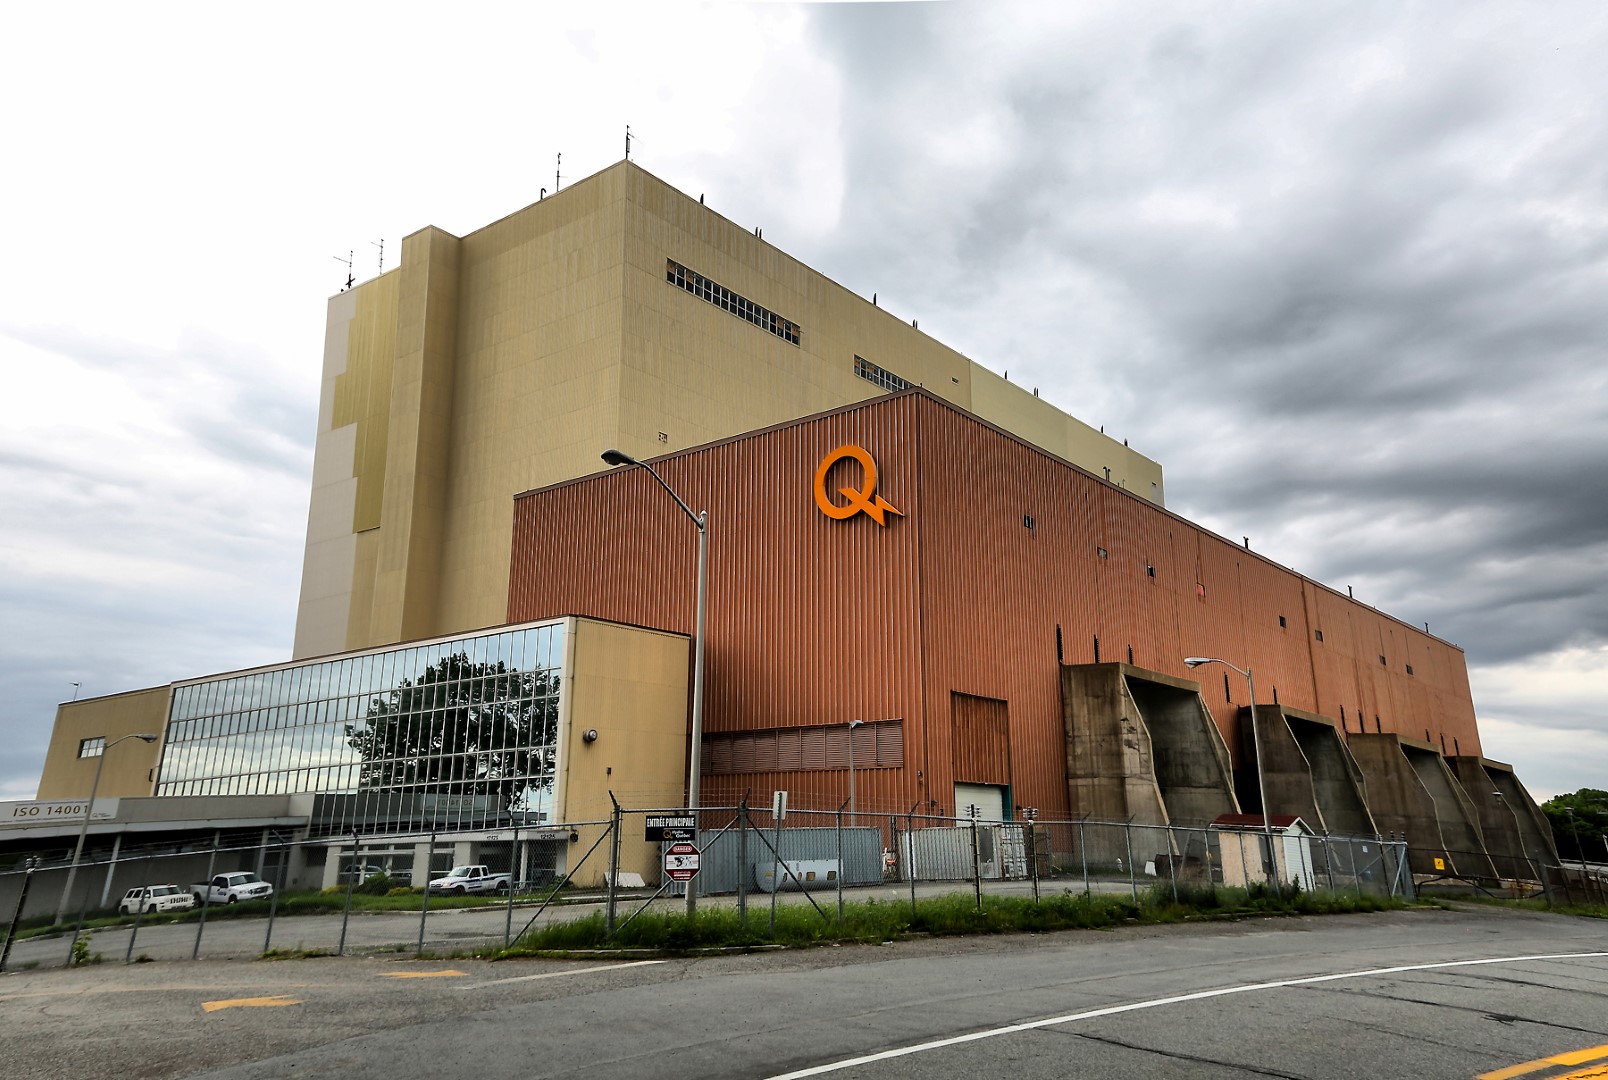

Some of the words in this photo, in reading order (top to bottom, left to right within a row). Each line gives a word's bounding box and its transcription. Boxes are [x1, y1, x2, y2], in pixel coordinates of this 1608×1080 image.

[814, 445, 905, 527] Q
[13, 806, 40, 817] ISO
[47, 805, 88, 815] 14001
[647, 816, 665, 827] ENTRÉE
[665, 817, 694, 827] PRINCIPALE
